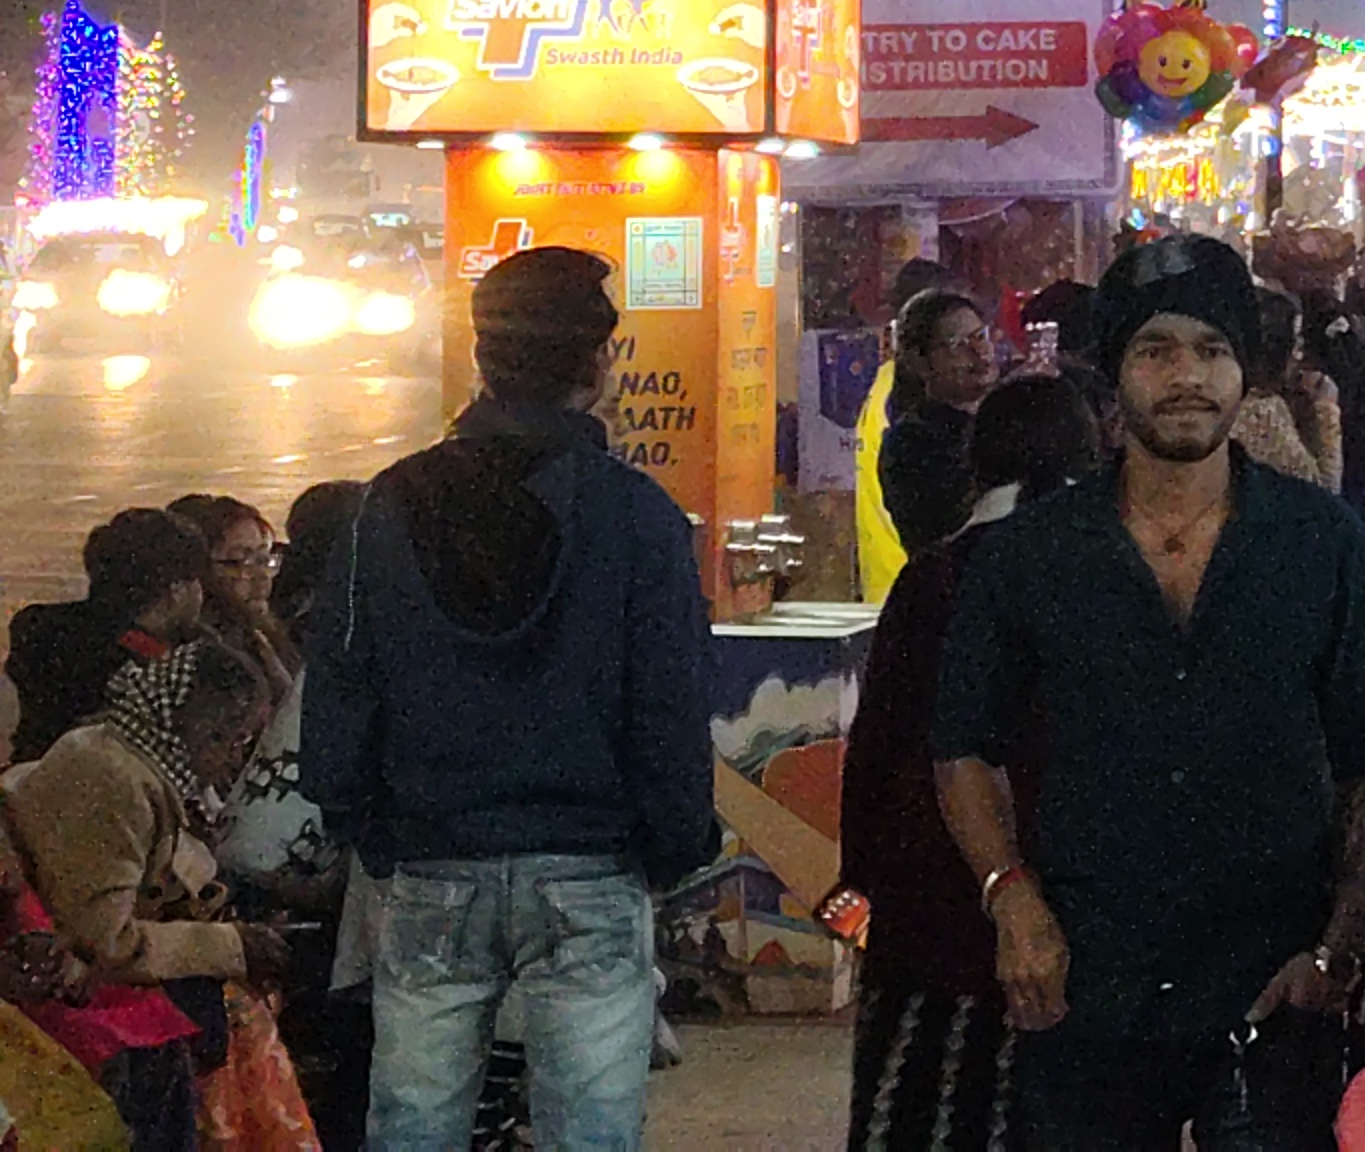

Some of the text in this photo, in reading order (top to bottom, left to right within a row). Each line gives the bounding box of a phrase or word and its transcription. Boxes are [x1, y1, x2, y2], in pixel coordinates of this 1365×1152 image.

[861, 28, 1057, 55] TRY TO CAKE
[545, 47, 684, 66] Swasth India
[860, 58, 1049, 85] ISTRIBUTION
